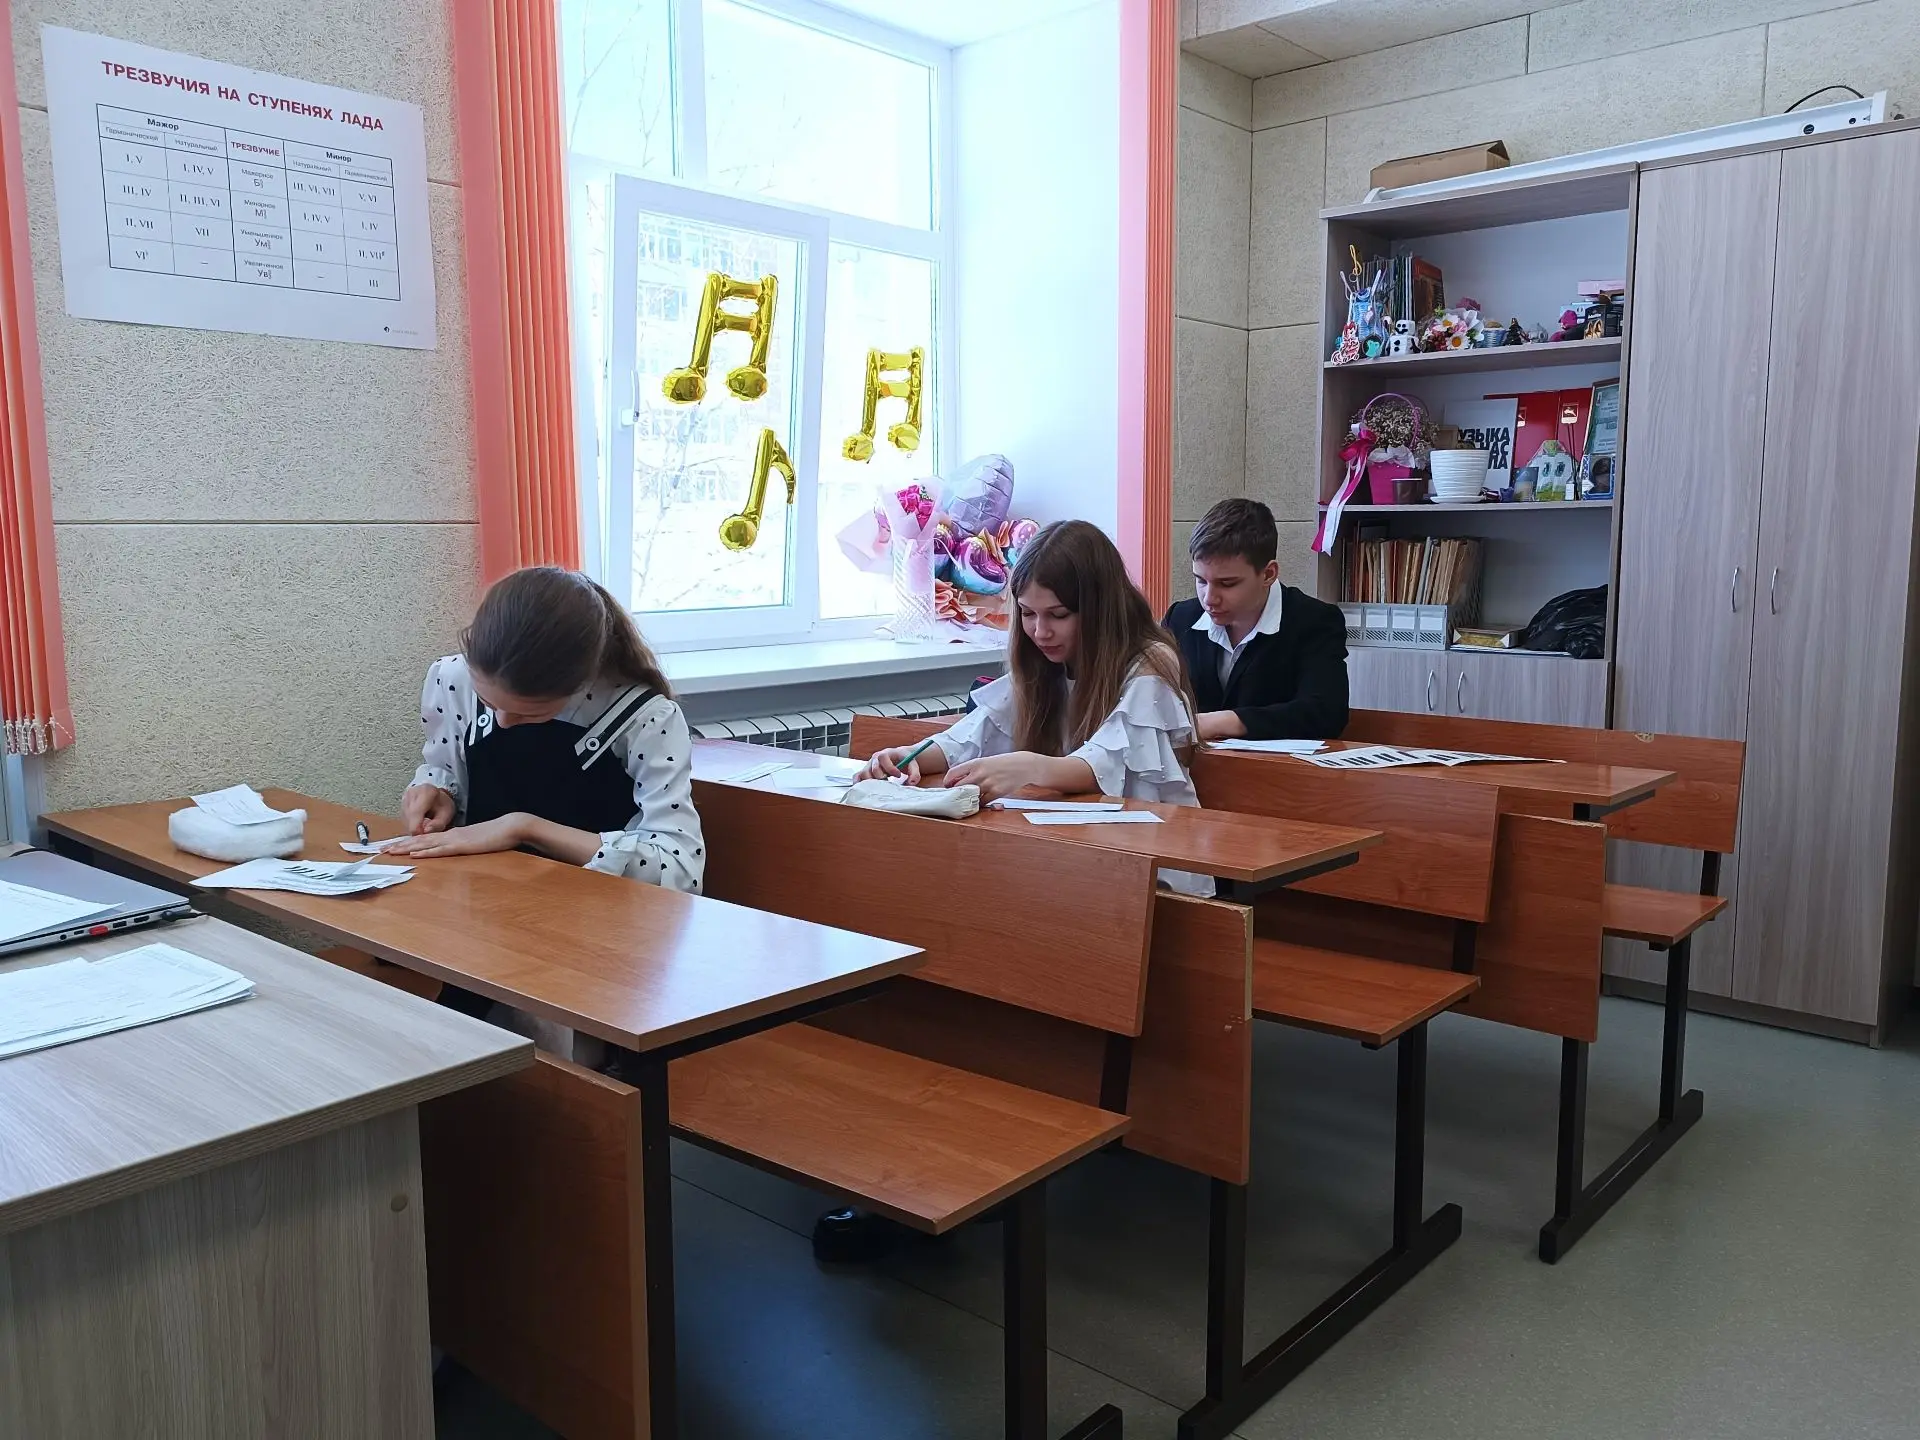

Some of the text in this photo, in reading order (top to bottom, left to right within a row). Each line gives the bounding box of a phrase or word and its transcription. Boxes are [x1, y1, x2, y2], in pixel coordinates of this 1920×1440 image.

[101, 60, 384, 131] ТРЕЗВУЧИЯ НА СТУПЕНЯХ ЛАДА
[146, 118, 180, 132] Мажор
[230, 141, 281, 157] ТРЕЗВУЧИЕ
[325, 151, 352, 163] Минор
[241, 168, 274, 180] Мажорное
[1457, 427, 1511, 443] УЗЫКА
